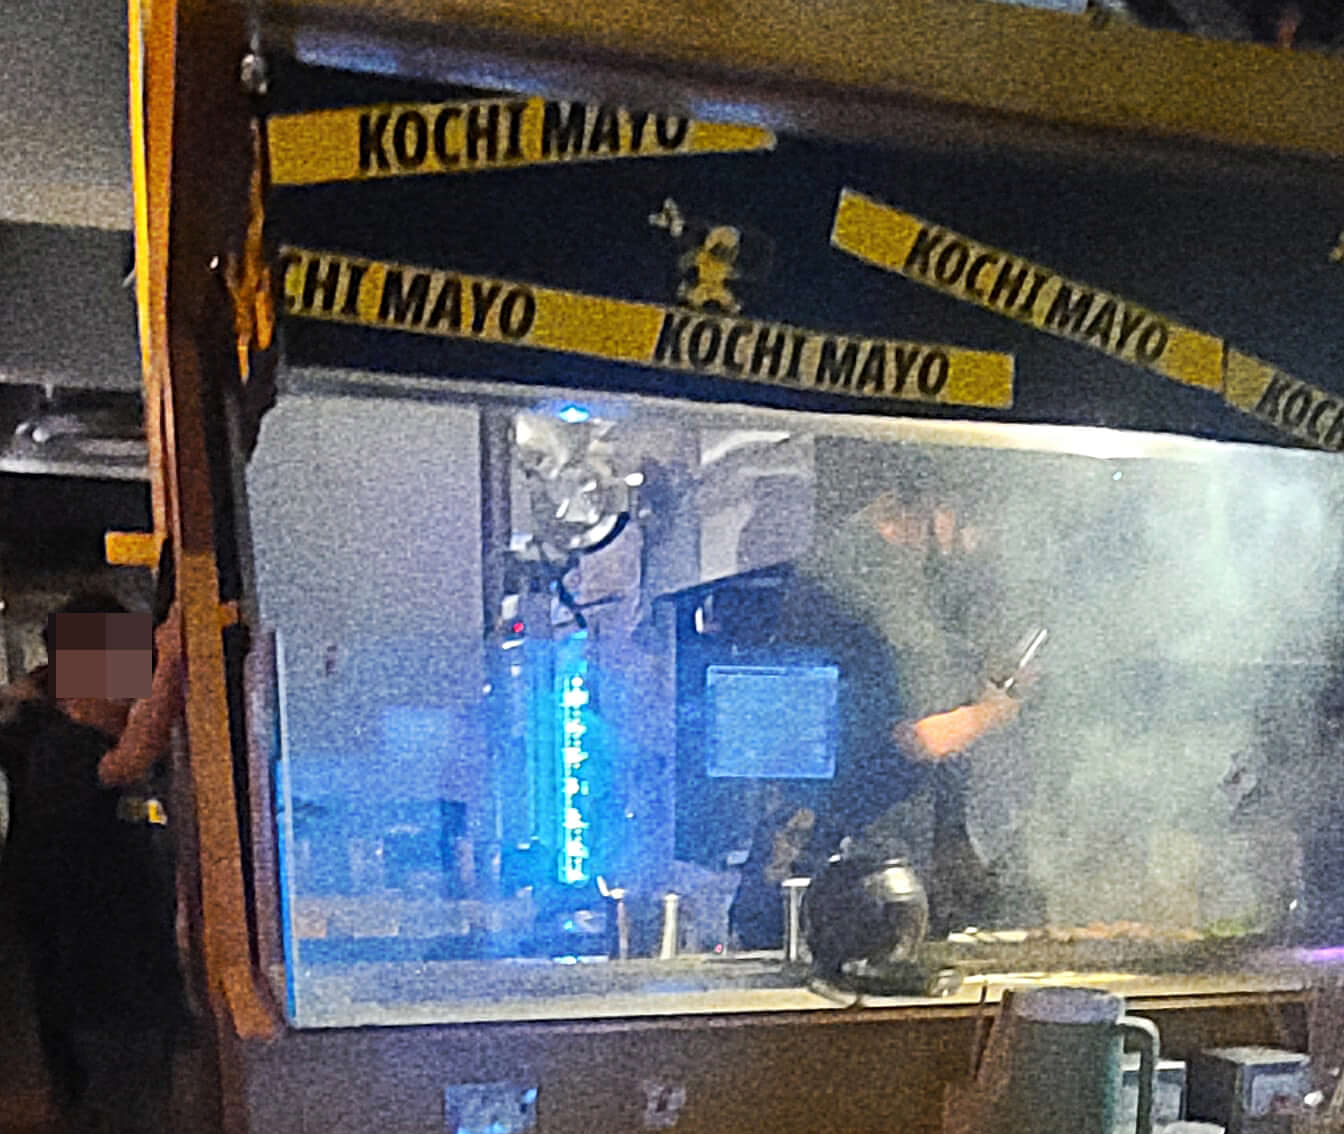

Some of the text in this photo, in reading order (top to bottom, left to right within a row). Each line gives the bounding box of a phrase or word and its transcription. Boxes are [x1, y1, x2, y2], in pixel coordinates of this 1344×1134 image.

[358, 100, 523, 172] KOCHI
[378, 268, 536, 341] MAYO
[905, 225, 1169, 365] KOCHI MAYO
[657, 309, 950, 397] KOCHI MAYO
